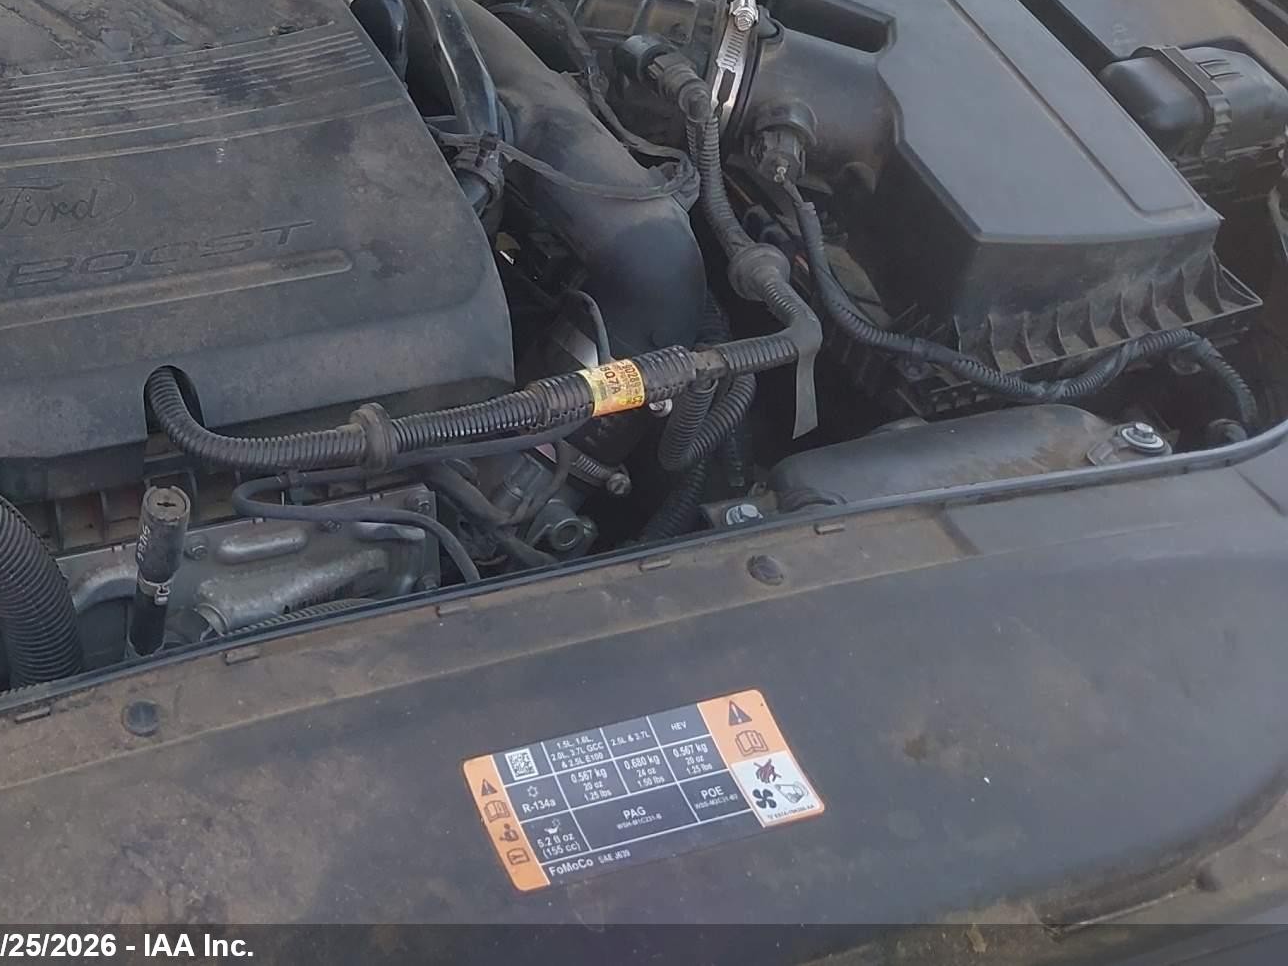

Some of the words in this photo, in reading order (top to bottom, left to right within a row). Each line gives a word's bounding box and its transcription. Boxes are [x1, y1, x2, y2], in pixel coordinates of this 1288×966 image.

[670, 721, 687, 731] HEV
[586, 742, 604, 752] GCC
[673, 745, 694, 758] 0.567
[695, 742, 708, 753] kg
[623, 756, 647, 770] 0.680
[647, 754, 661, 765] kg
[685, 756, 695, 765] 20
[636, 768, 647, 778] 24
[647, 767, 657, 775] oz
[686, 765, 702, 775] 1.25
[701, 763, 713, 772] lbs
[571, 770, 592, 784] 0.567
[594, 768, 608, 779] kg
[636, 777, 653, 787] 1.50
[653, 775, 665, 784] lbs
[583, 782, 593, 791] 20
[594, 780, 604, 788] oz
[584, 792, 600, 802] 1.25
[599, 789, 612, 799] lbs
[701, 785, 724, 800] POE
[521, 798, 556, 813] R-134a
[622, 806, 646, 820] PAG
[562, 833, 575, 842] oz
[542, 845, 564, 859] (155
[565, 840, 582, 852] cc)
[548, 858, 594, 876] FoMoCo
